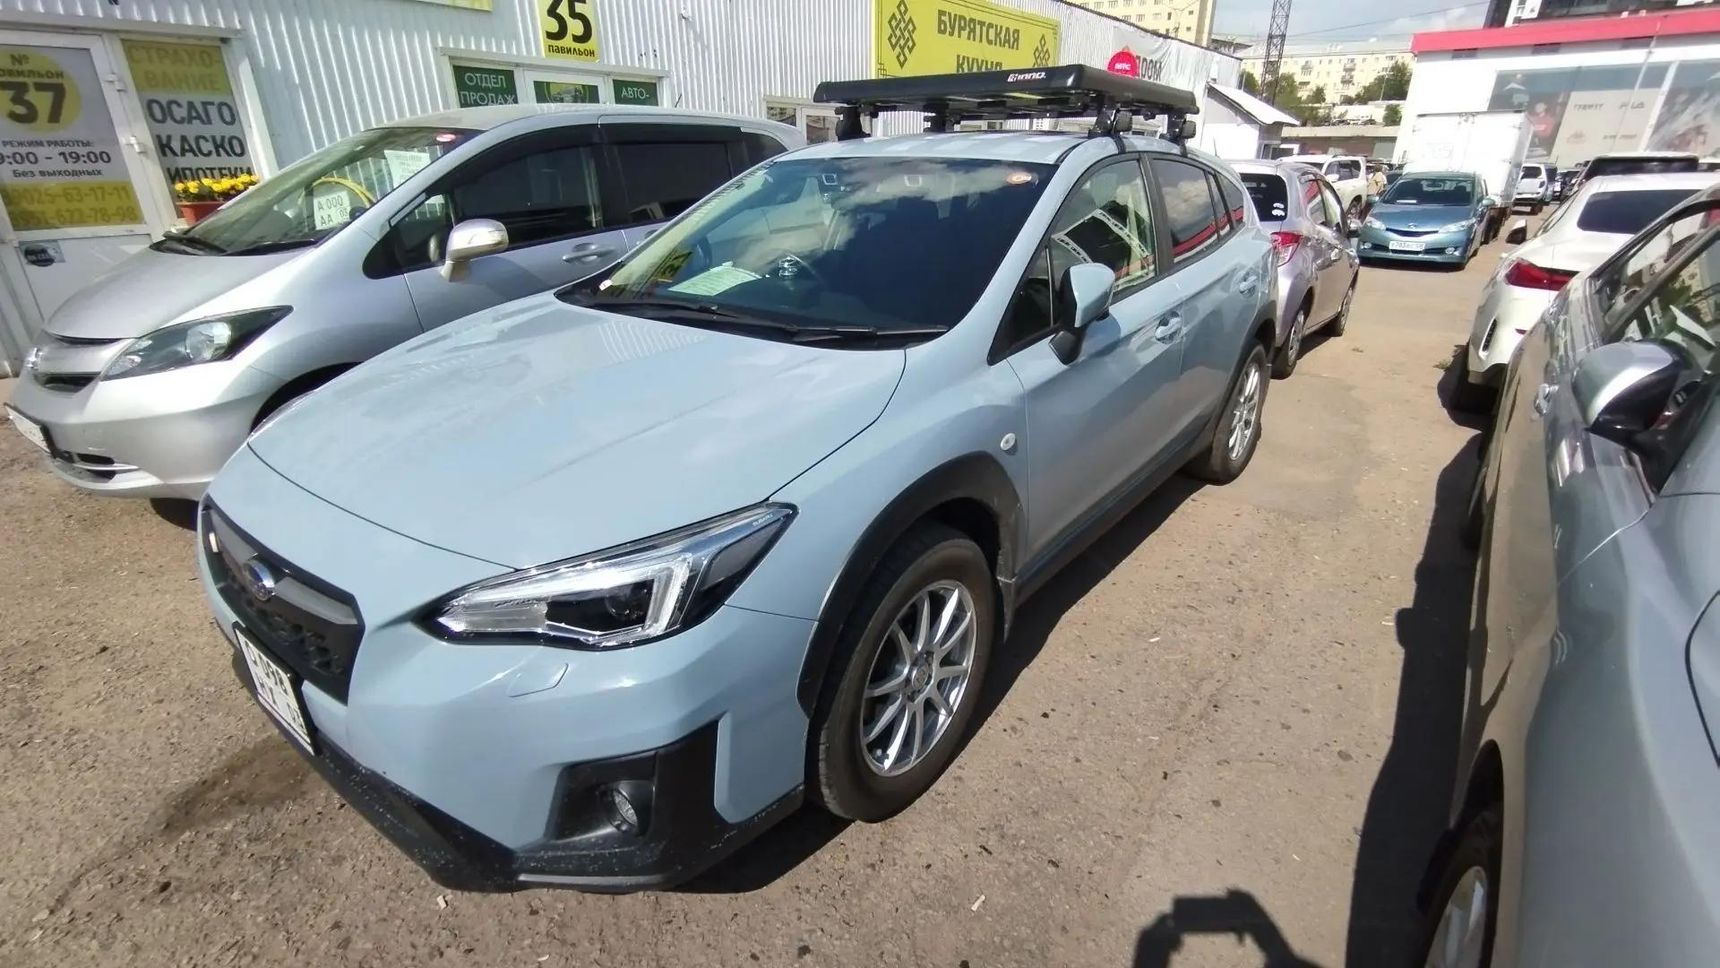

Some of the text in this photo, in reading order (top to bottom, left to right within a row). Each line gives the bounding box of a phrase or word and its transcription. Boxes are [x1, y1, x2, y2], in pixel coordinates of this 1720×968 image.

[545, 0, 593, 44] 35
[937, 9, 1020, 51] БУРЯТСКАЯ
[547, 44, 596, 58] павильон
[464, 72, 507, 89] ОТДЕЛ
[459, 91, 516, 107] ПРОДАЖ
[621, 87, 649, 99] АВТО-
[0, 81, 66, 124] 37
[146, 99, 237, 126] ОСАГО
[2, 140, 44, 148] РЕЖИМ
[155, 134, 246, 158] КАСКО
[58, 150, 112, 164] 19:00
[13, 169, 103, 178] Без выходных
